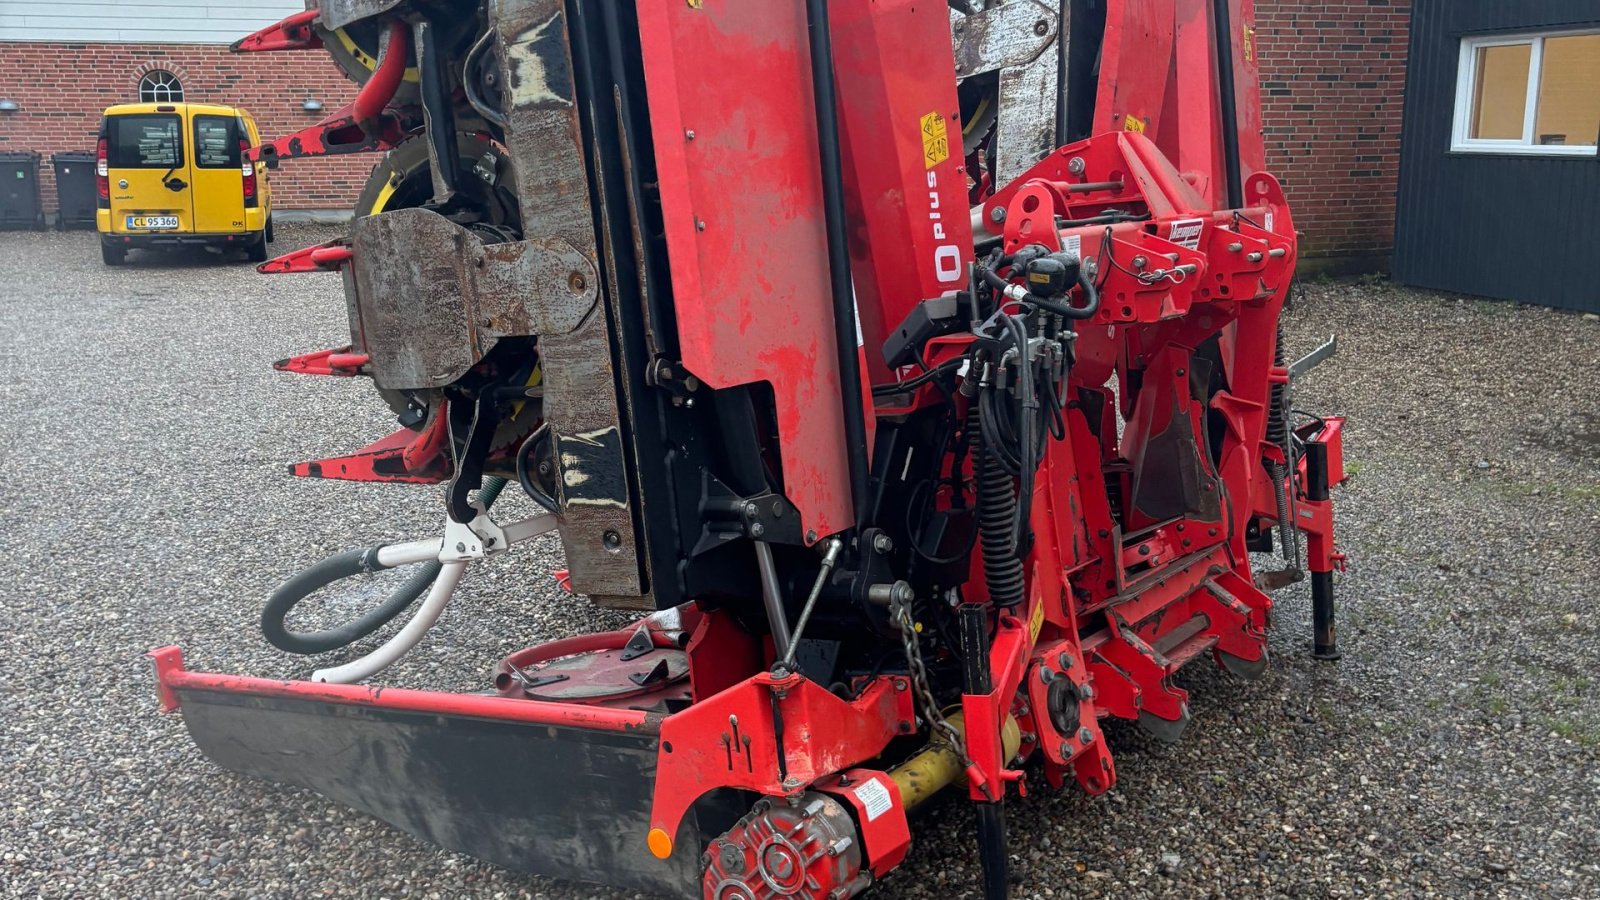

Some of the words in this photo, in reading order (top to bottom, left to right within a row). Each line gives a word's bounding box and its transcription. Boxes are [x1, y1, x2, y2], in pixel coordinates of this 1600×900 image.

[134, 217, 146, 227] CL
[147, 217, 159, 226] 95
[160, 217, 177, 226] 366
[927, 171, 946, 239] plus
